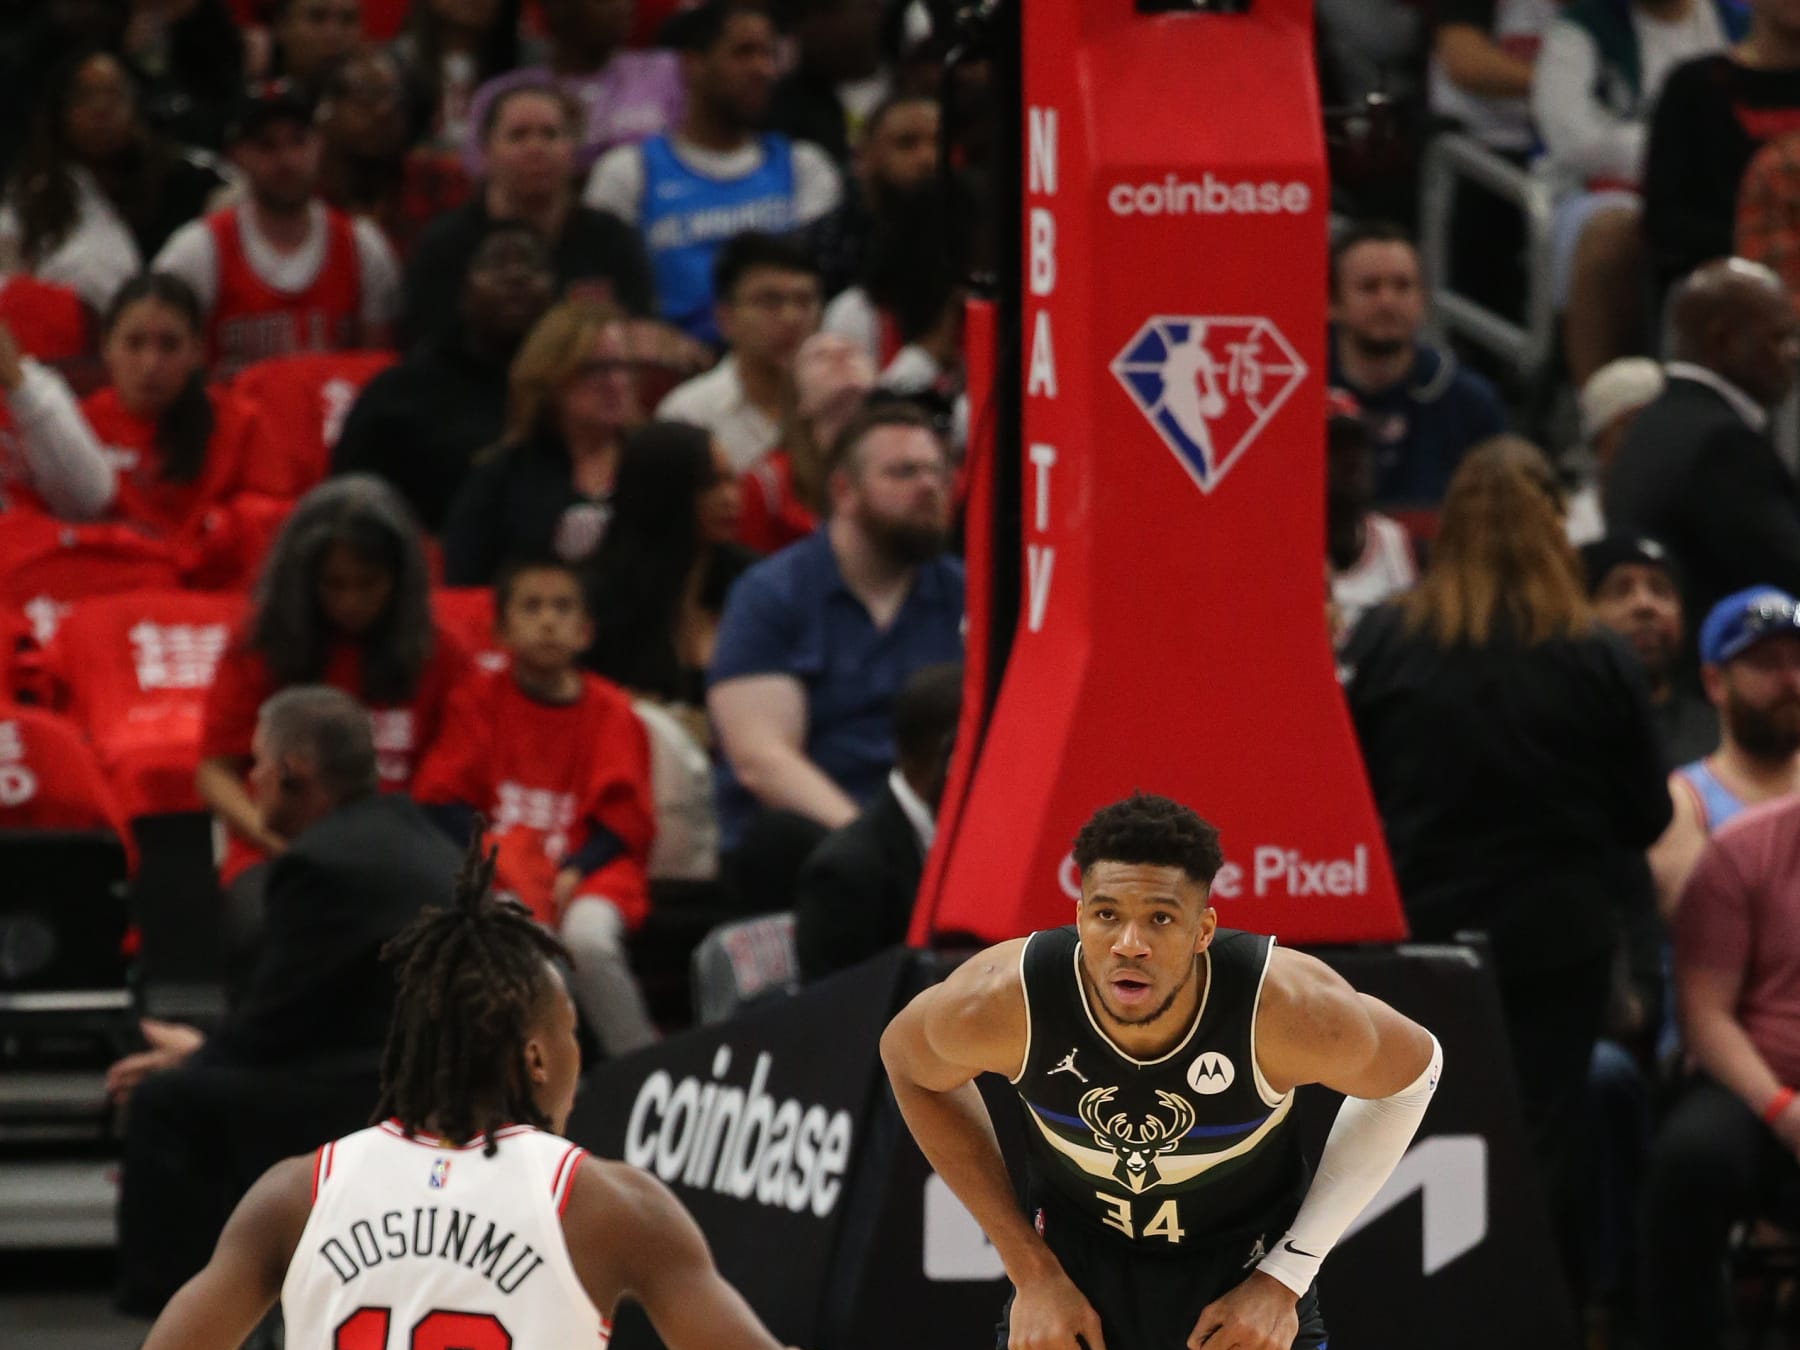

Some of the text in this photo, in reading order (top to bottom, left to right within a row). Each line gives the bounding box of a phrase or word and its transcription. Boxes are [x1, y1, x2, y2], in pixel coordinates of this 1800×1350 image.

[1108, 172, 1311, 215] coinbase
[1028, 105, 1058, 633] NBA TV
[1225, 341, 1262, 394] 75
[1253, 845, 1368, 897] Pixel
[624, 1044, 853, 1217] coinbase
[1095, 1191, 1185, 1243] 34
[319, 1206, 543, 1294] DOSUNMU
